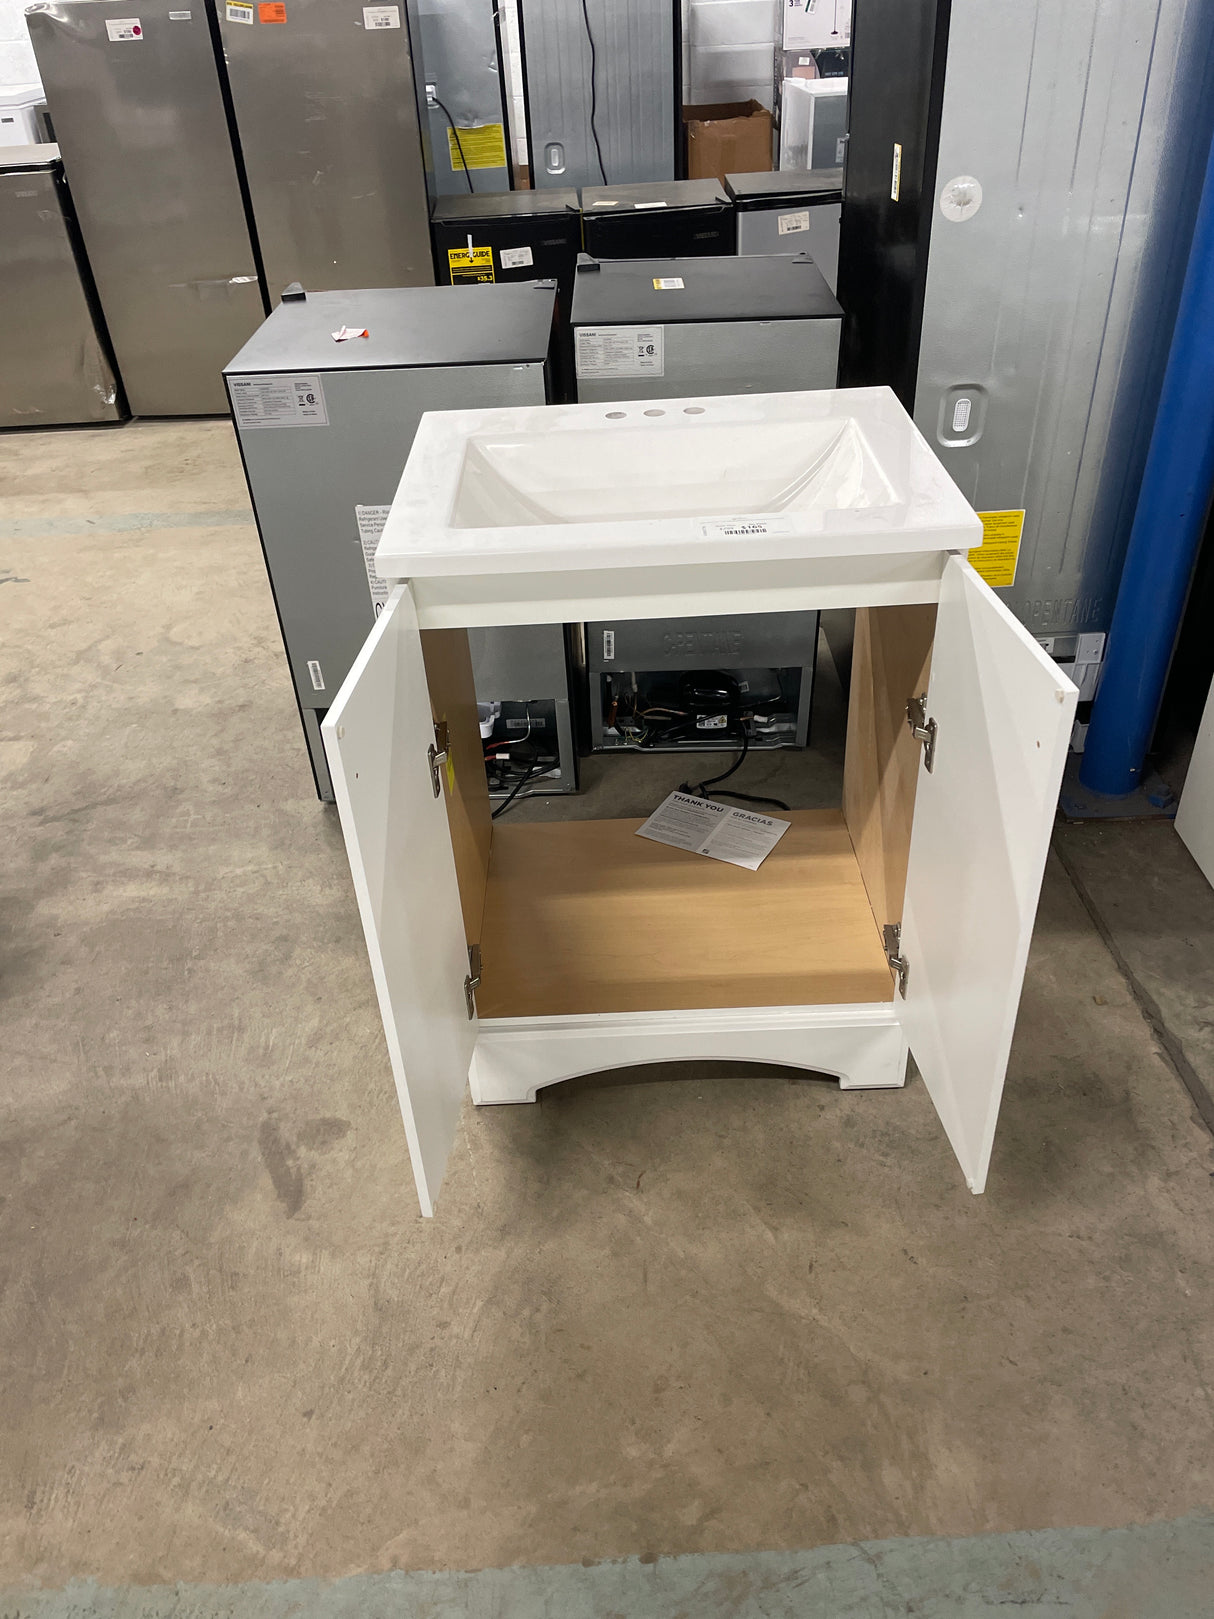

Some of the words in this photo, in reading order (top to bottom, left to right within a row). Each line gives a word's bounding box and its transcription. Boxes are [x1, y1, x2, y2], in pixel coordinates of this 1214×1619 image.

[450, 250, 490, 260] ENERGGUIDE
[673, 794, 702, 807] THANK
[704, 803, 724, 813] YOU
[732, 811, 774, 826] GRACIAS
